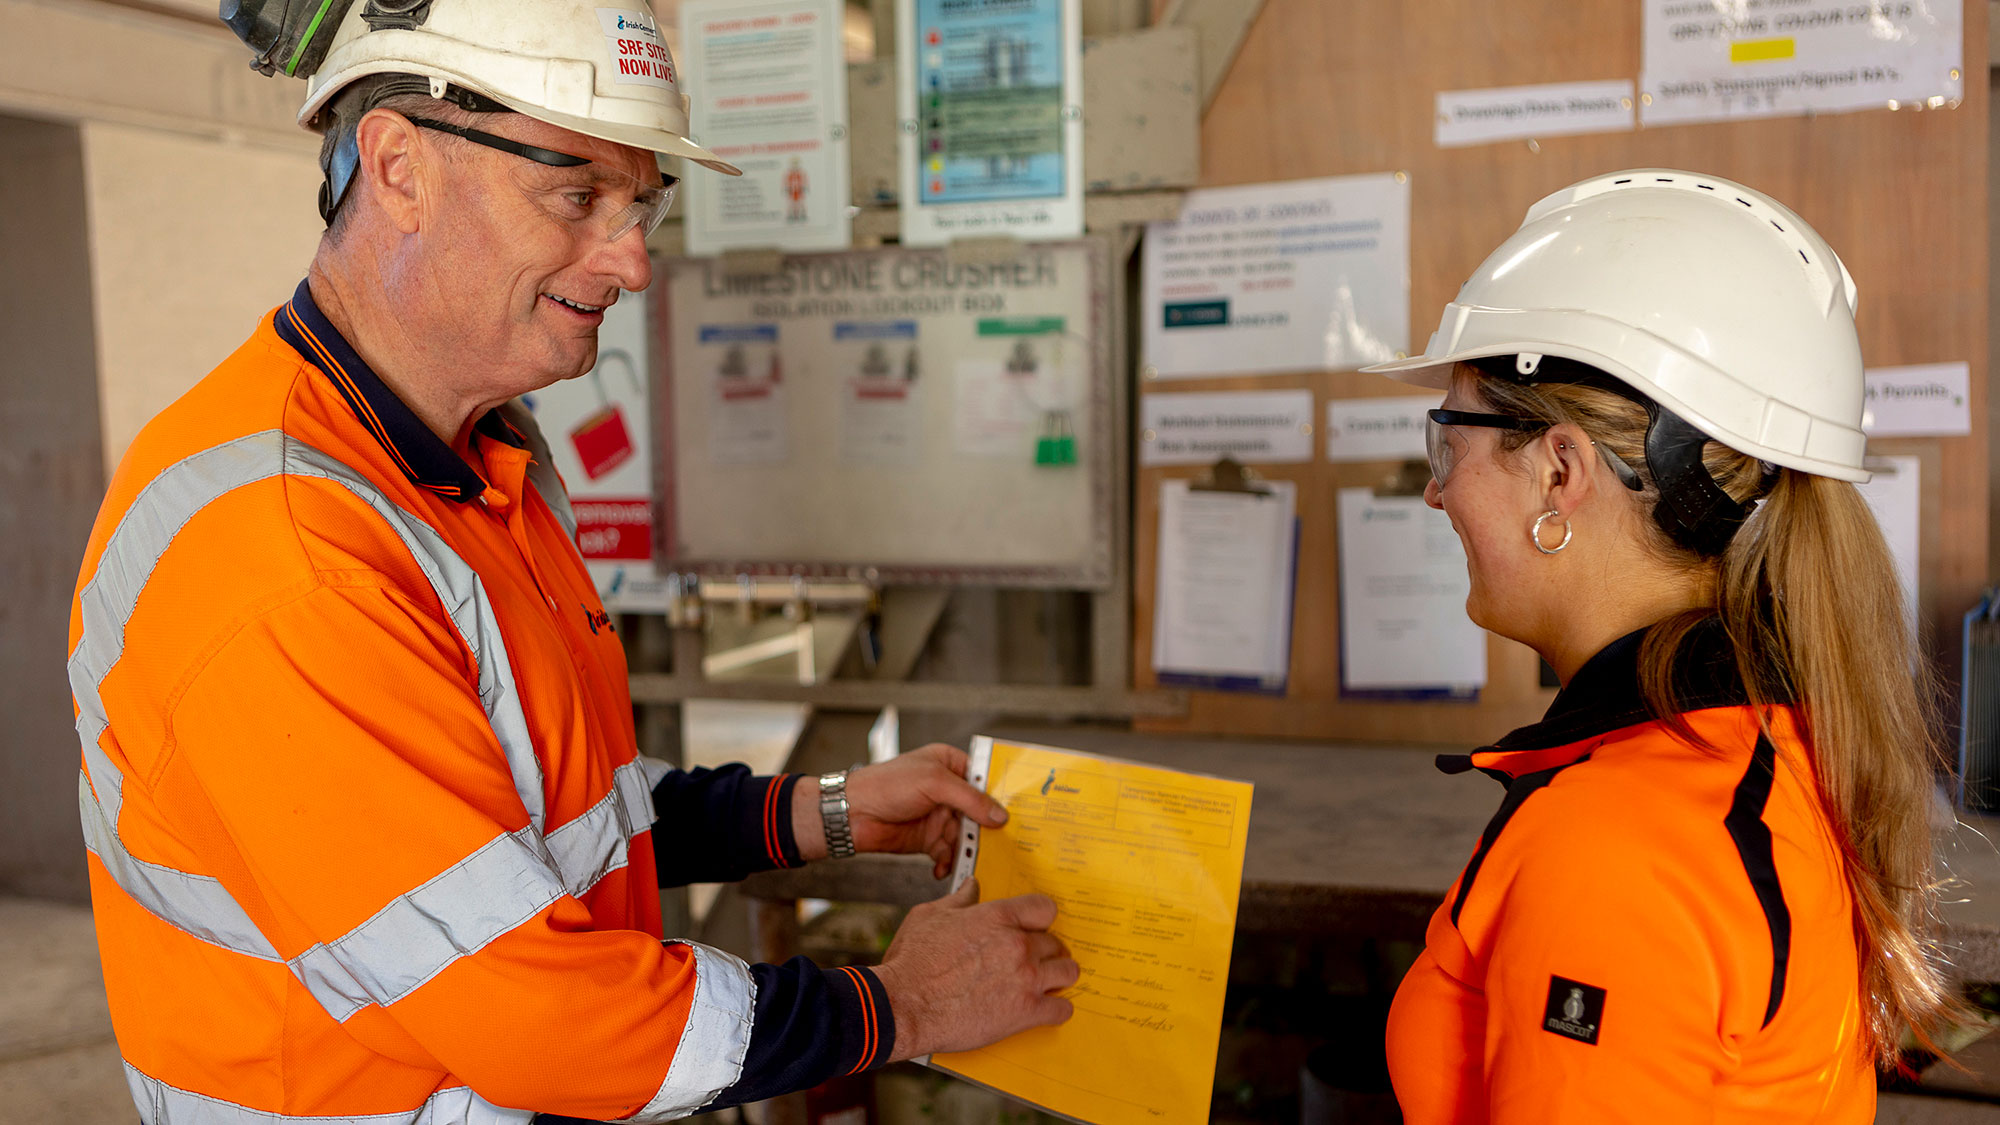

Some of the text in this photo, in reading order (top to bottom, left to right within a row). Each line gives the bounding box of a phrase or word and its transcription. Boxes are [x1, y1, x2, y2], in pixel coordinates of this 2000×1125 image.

[618, 38, 669, 62] SRF SITE
[619, 58, 673, 83] NOW LIVE
[704, 252, 1057, 296] LIMESTONE CRUSHER
[1547, 1017, 1593, 1039] MASCOT
